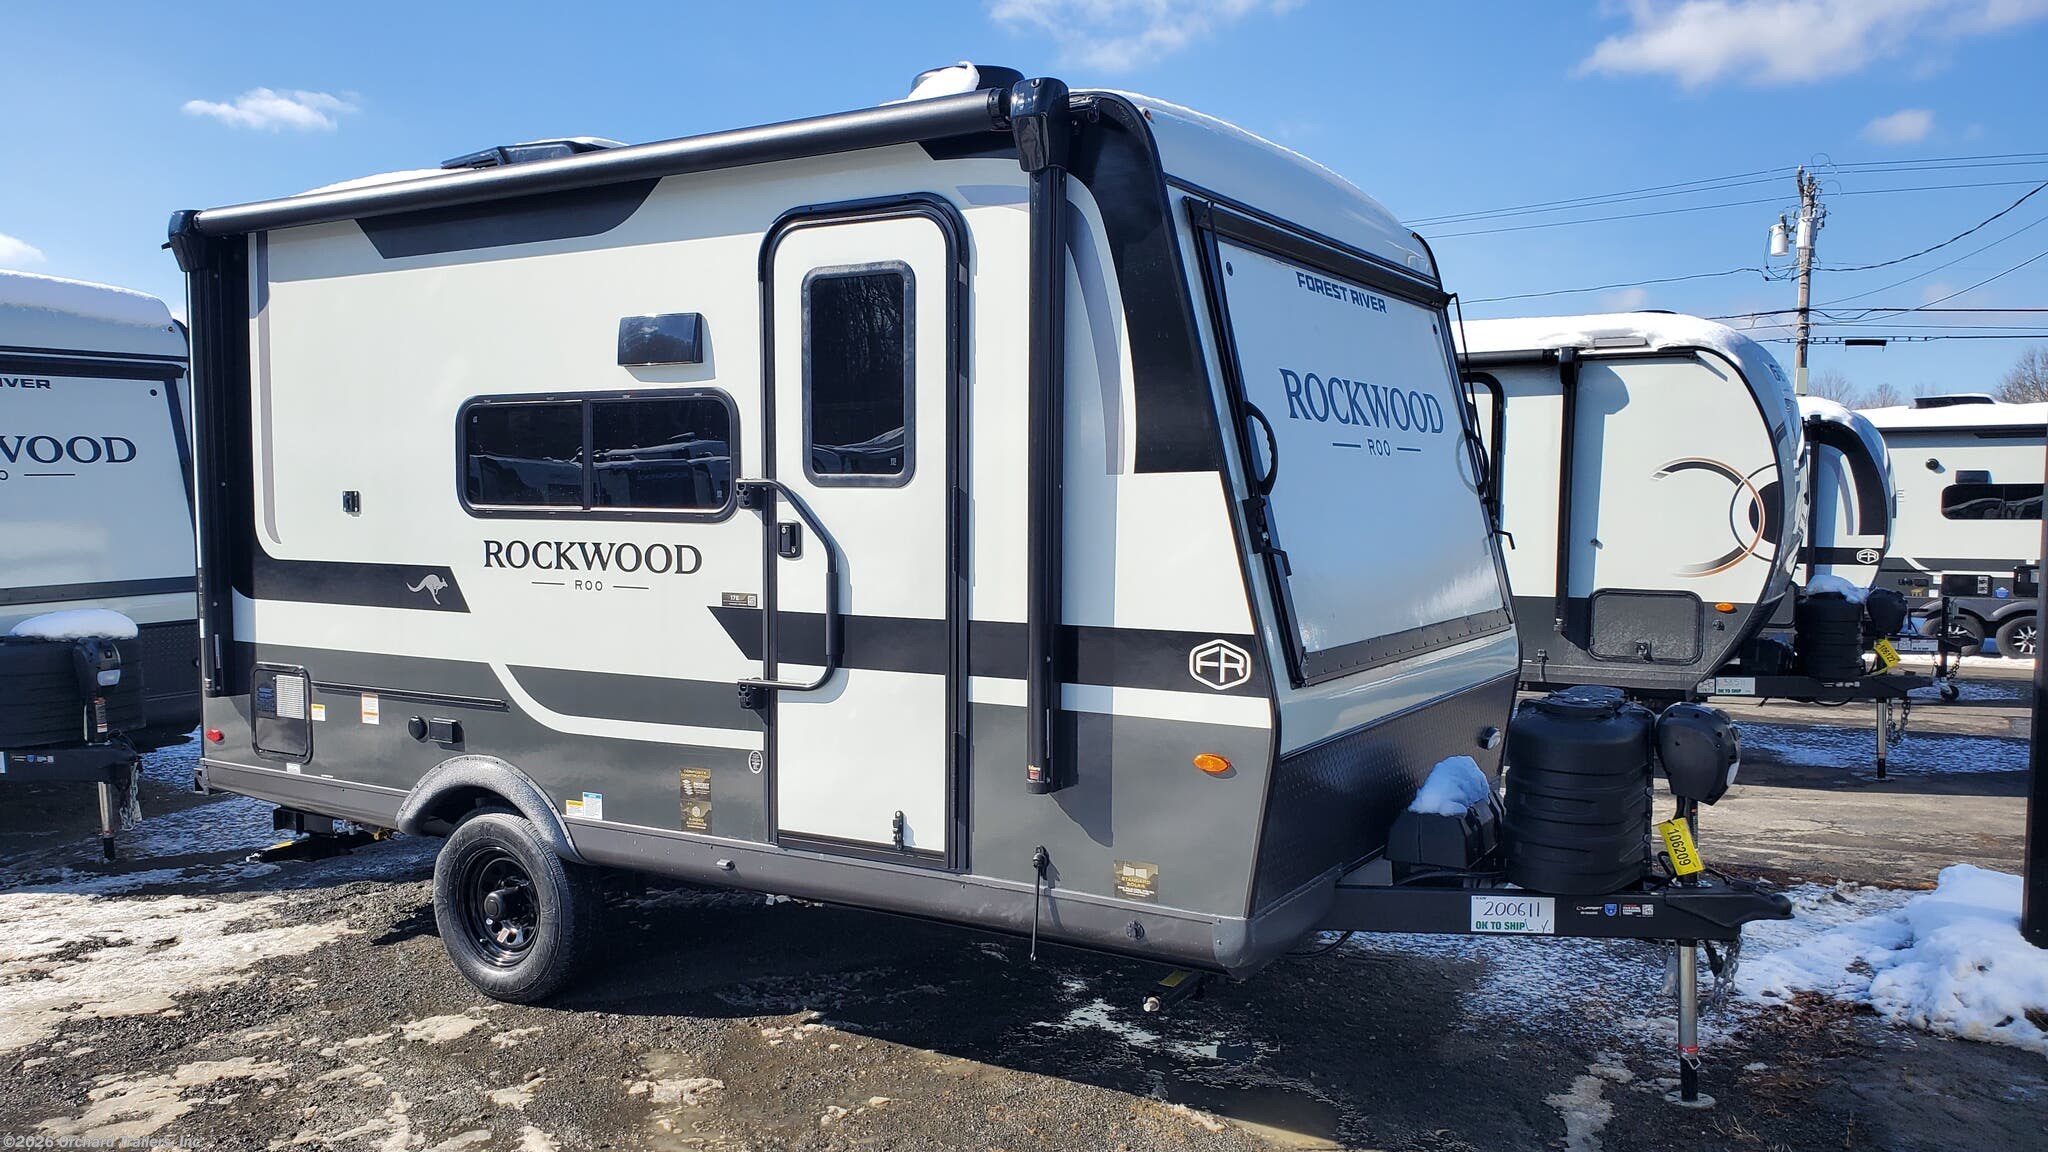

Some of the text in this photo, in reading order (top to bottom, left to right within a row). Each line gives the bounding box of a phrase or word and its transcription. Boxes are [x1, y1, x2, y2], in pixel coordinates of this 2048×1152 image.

[1295, 271, 1387, 314] FOREST RIVER
[1279, 368, 1444, 433] ROCKWOOD
[1367, 438, 1391, 456] ROO
[483, 540, 702, 575] ROCKWOOD
[574, 579, 603, 591] ROO
[1667, 828, 1691, 866] 106209
[1483, 901, 1541, 918] 200611
[1475, 920, 1526, 931] OK TO SHIP
